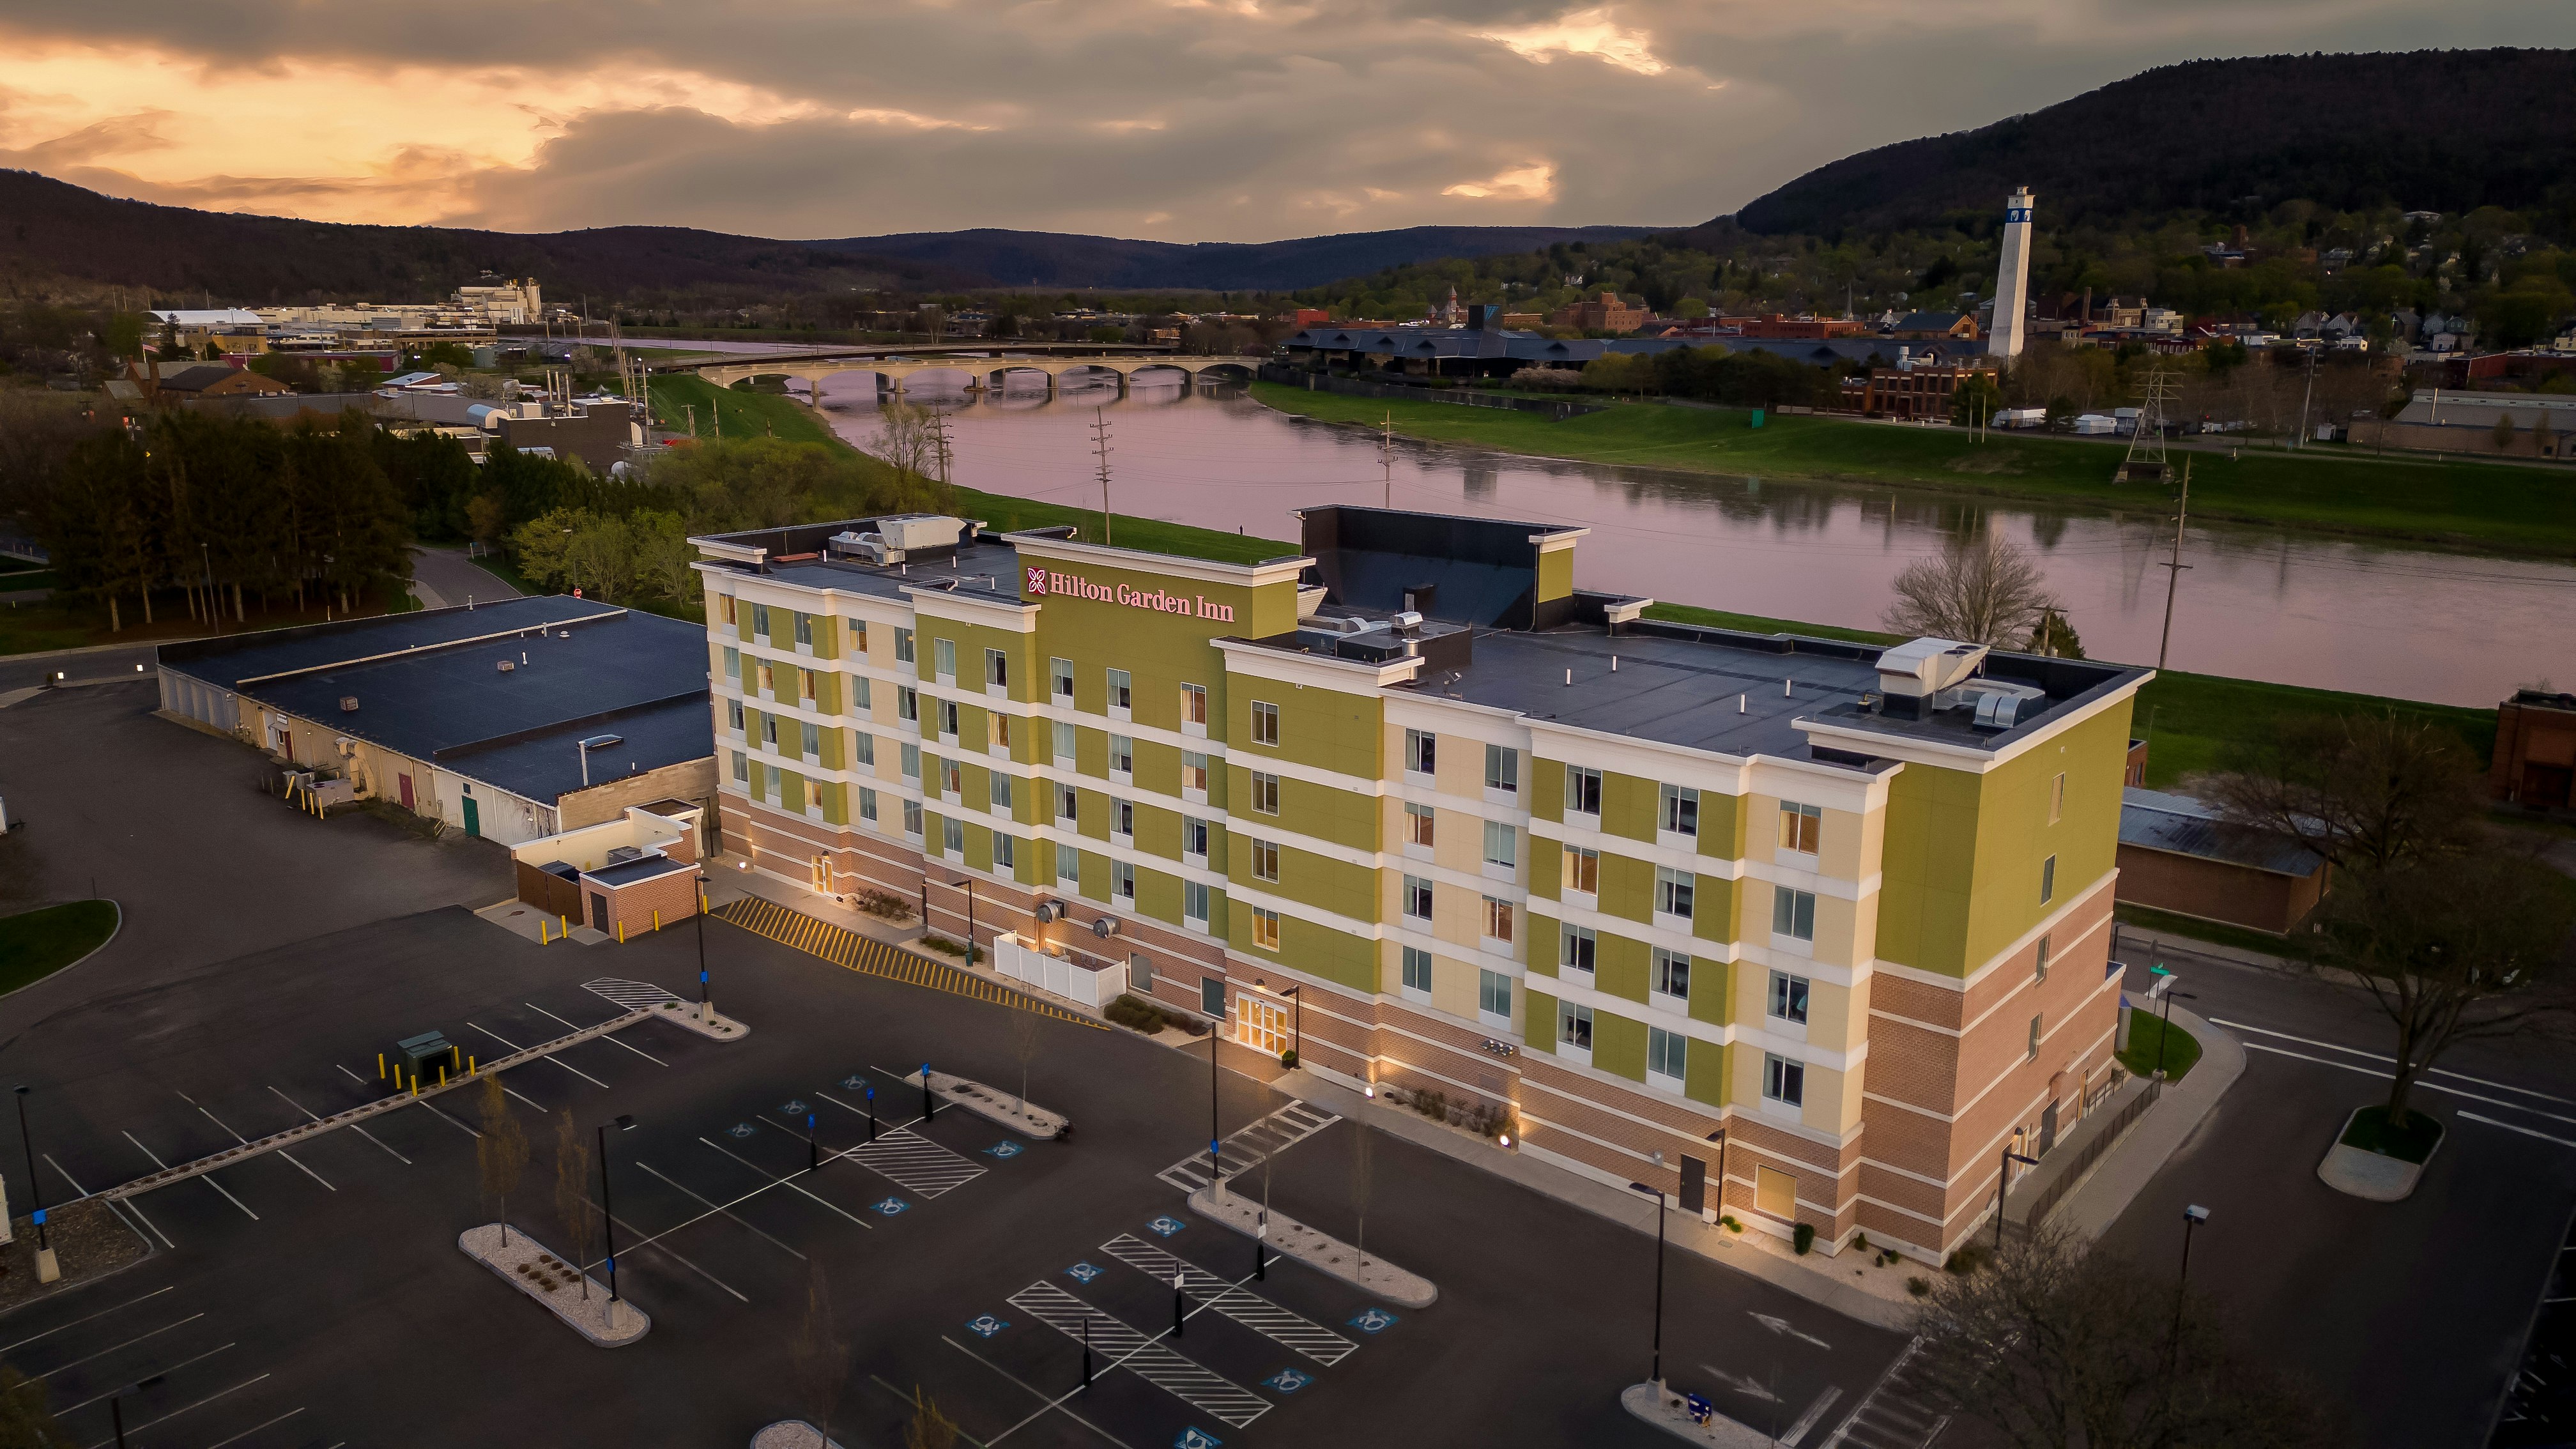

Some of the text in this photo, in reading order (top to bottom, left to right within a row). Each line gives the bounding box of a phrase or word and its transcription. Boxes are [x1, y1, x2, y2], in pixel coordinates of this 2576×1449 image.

[1050, 572, 1235, 622] Hilton Garden Inn
